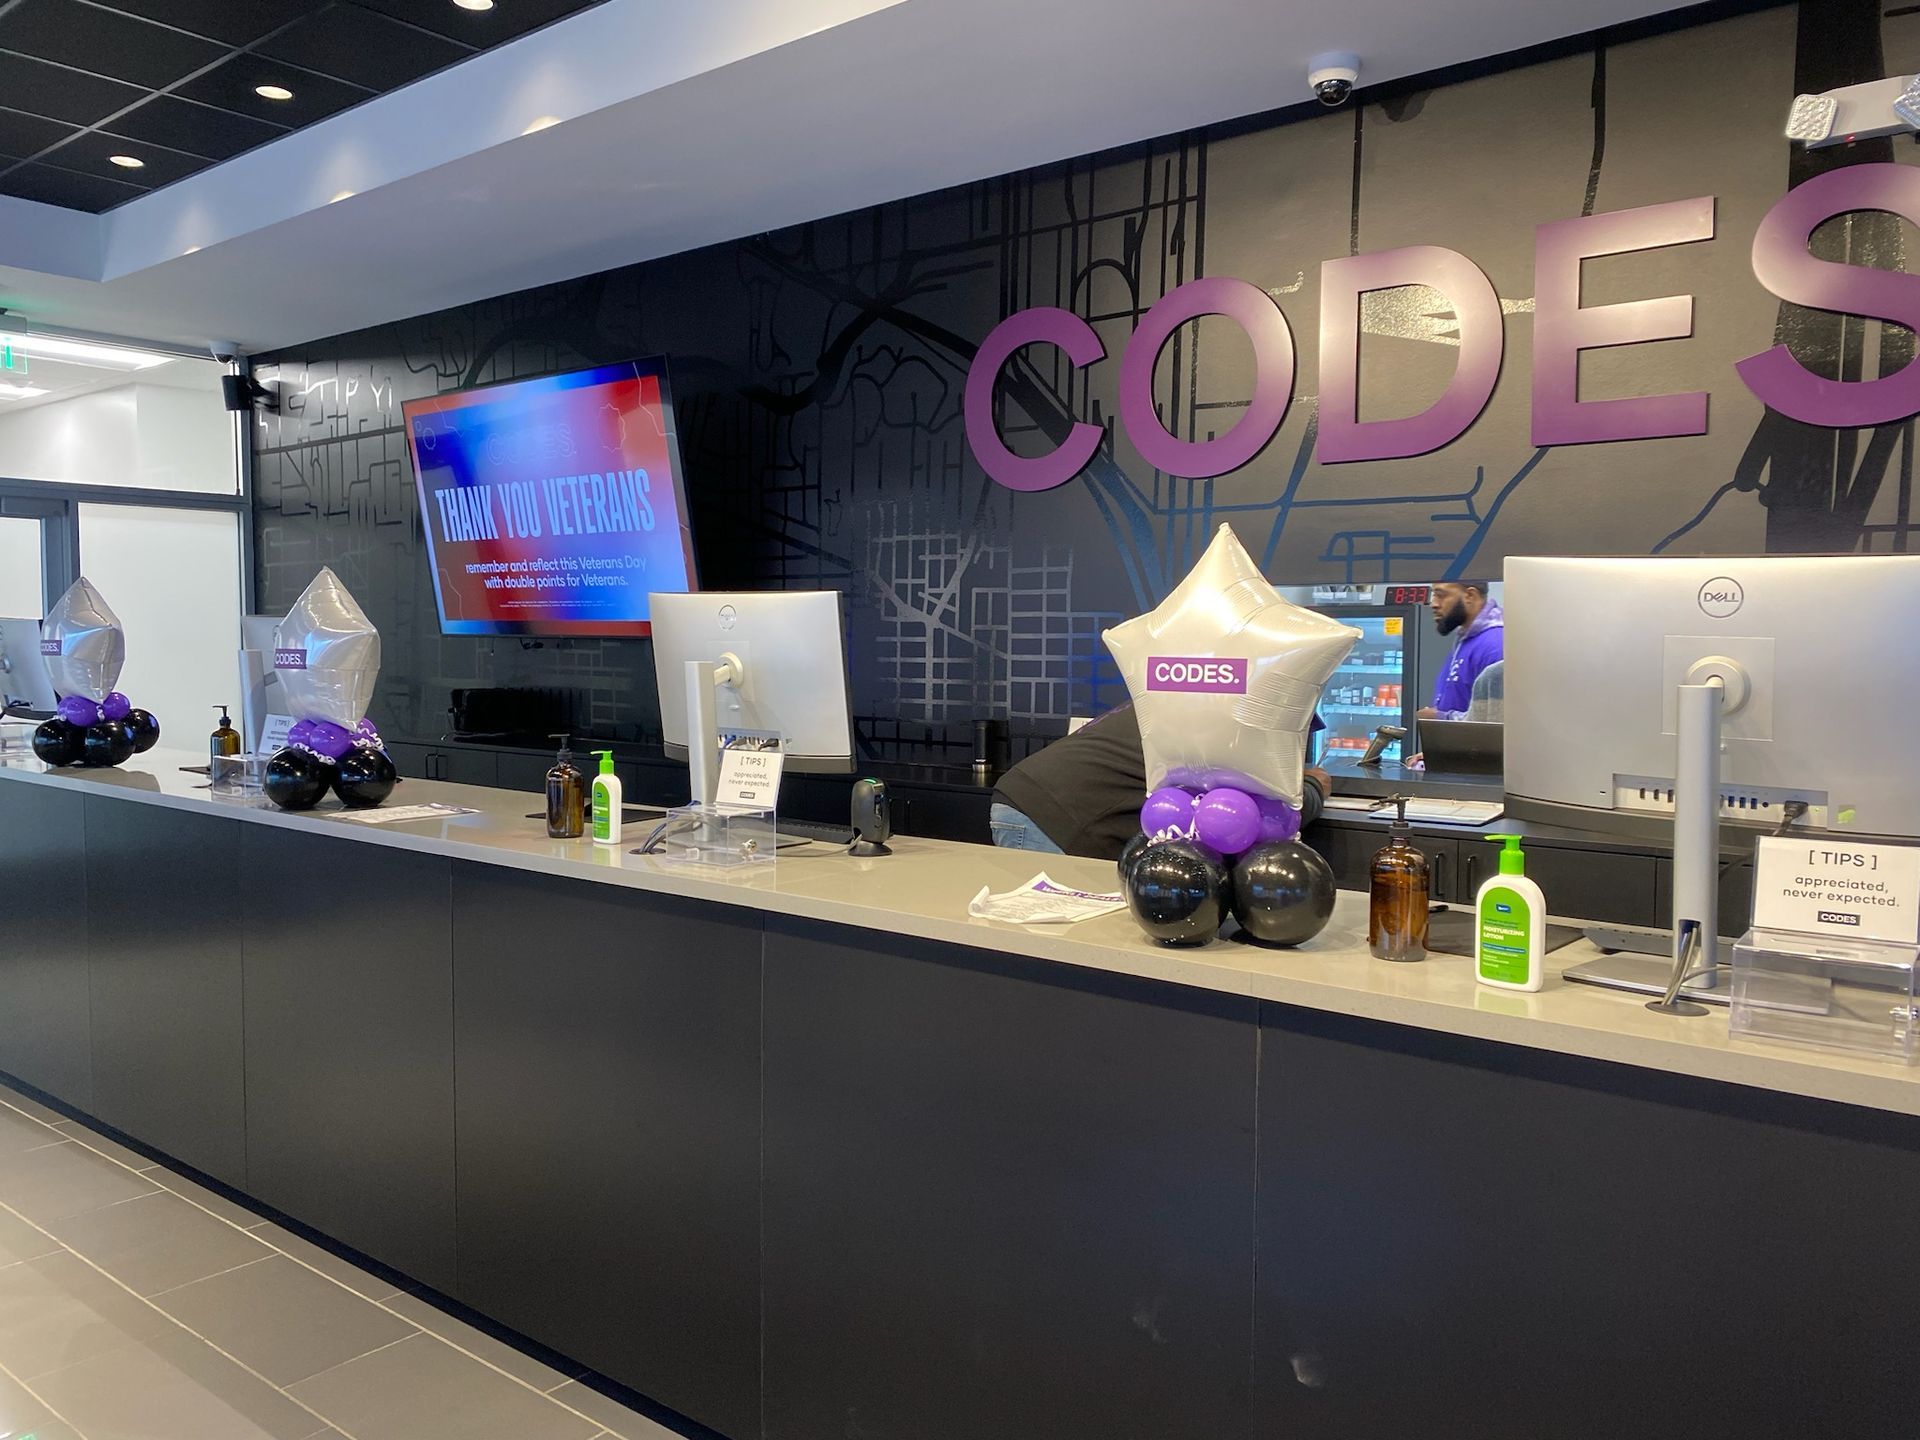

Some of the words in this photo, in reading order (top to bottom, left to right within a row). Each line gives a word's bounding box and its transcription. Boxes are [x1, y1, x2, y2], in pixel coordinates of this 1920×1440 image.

[963, 162, 1920, 492] CODES
[435, 485, 499, 542] THANK
[498, 480, 542, 538] YOU
[542, 468, 655, 536] VETERANS
[465, 560, 508, 574] remember
[510, 559, 528, 572] and
[529, 557, 559, 571] reflect
[560, 556, 578, 570] this
[578, 556, 623, 570] Veterans
[625, 555, 647, 572] Day
[484, 576, 504, 589] with
[505, 575, 535, 588] double
[537, 574, 565, 591] points
[566, 573, 580, 587] for
[580, 573, 629, 587] Veterans.
[1703, 592, 1739, 602] DELL
[1155, 662, 1239, 684] CODES.
[746, 757, 761, 766] TIPS
[1821, 851, 1865, 867] TIPS
[1795, 876, 1889, 894] appreciated,
[1783, 887, 1823, 900] never
[1827, 891, 1900, 907] expected.
[1820, 912, 1857, 924] CODES
